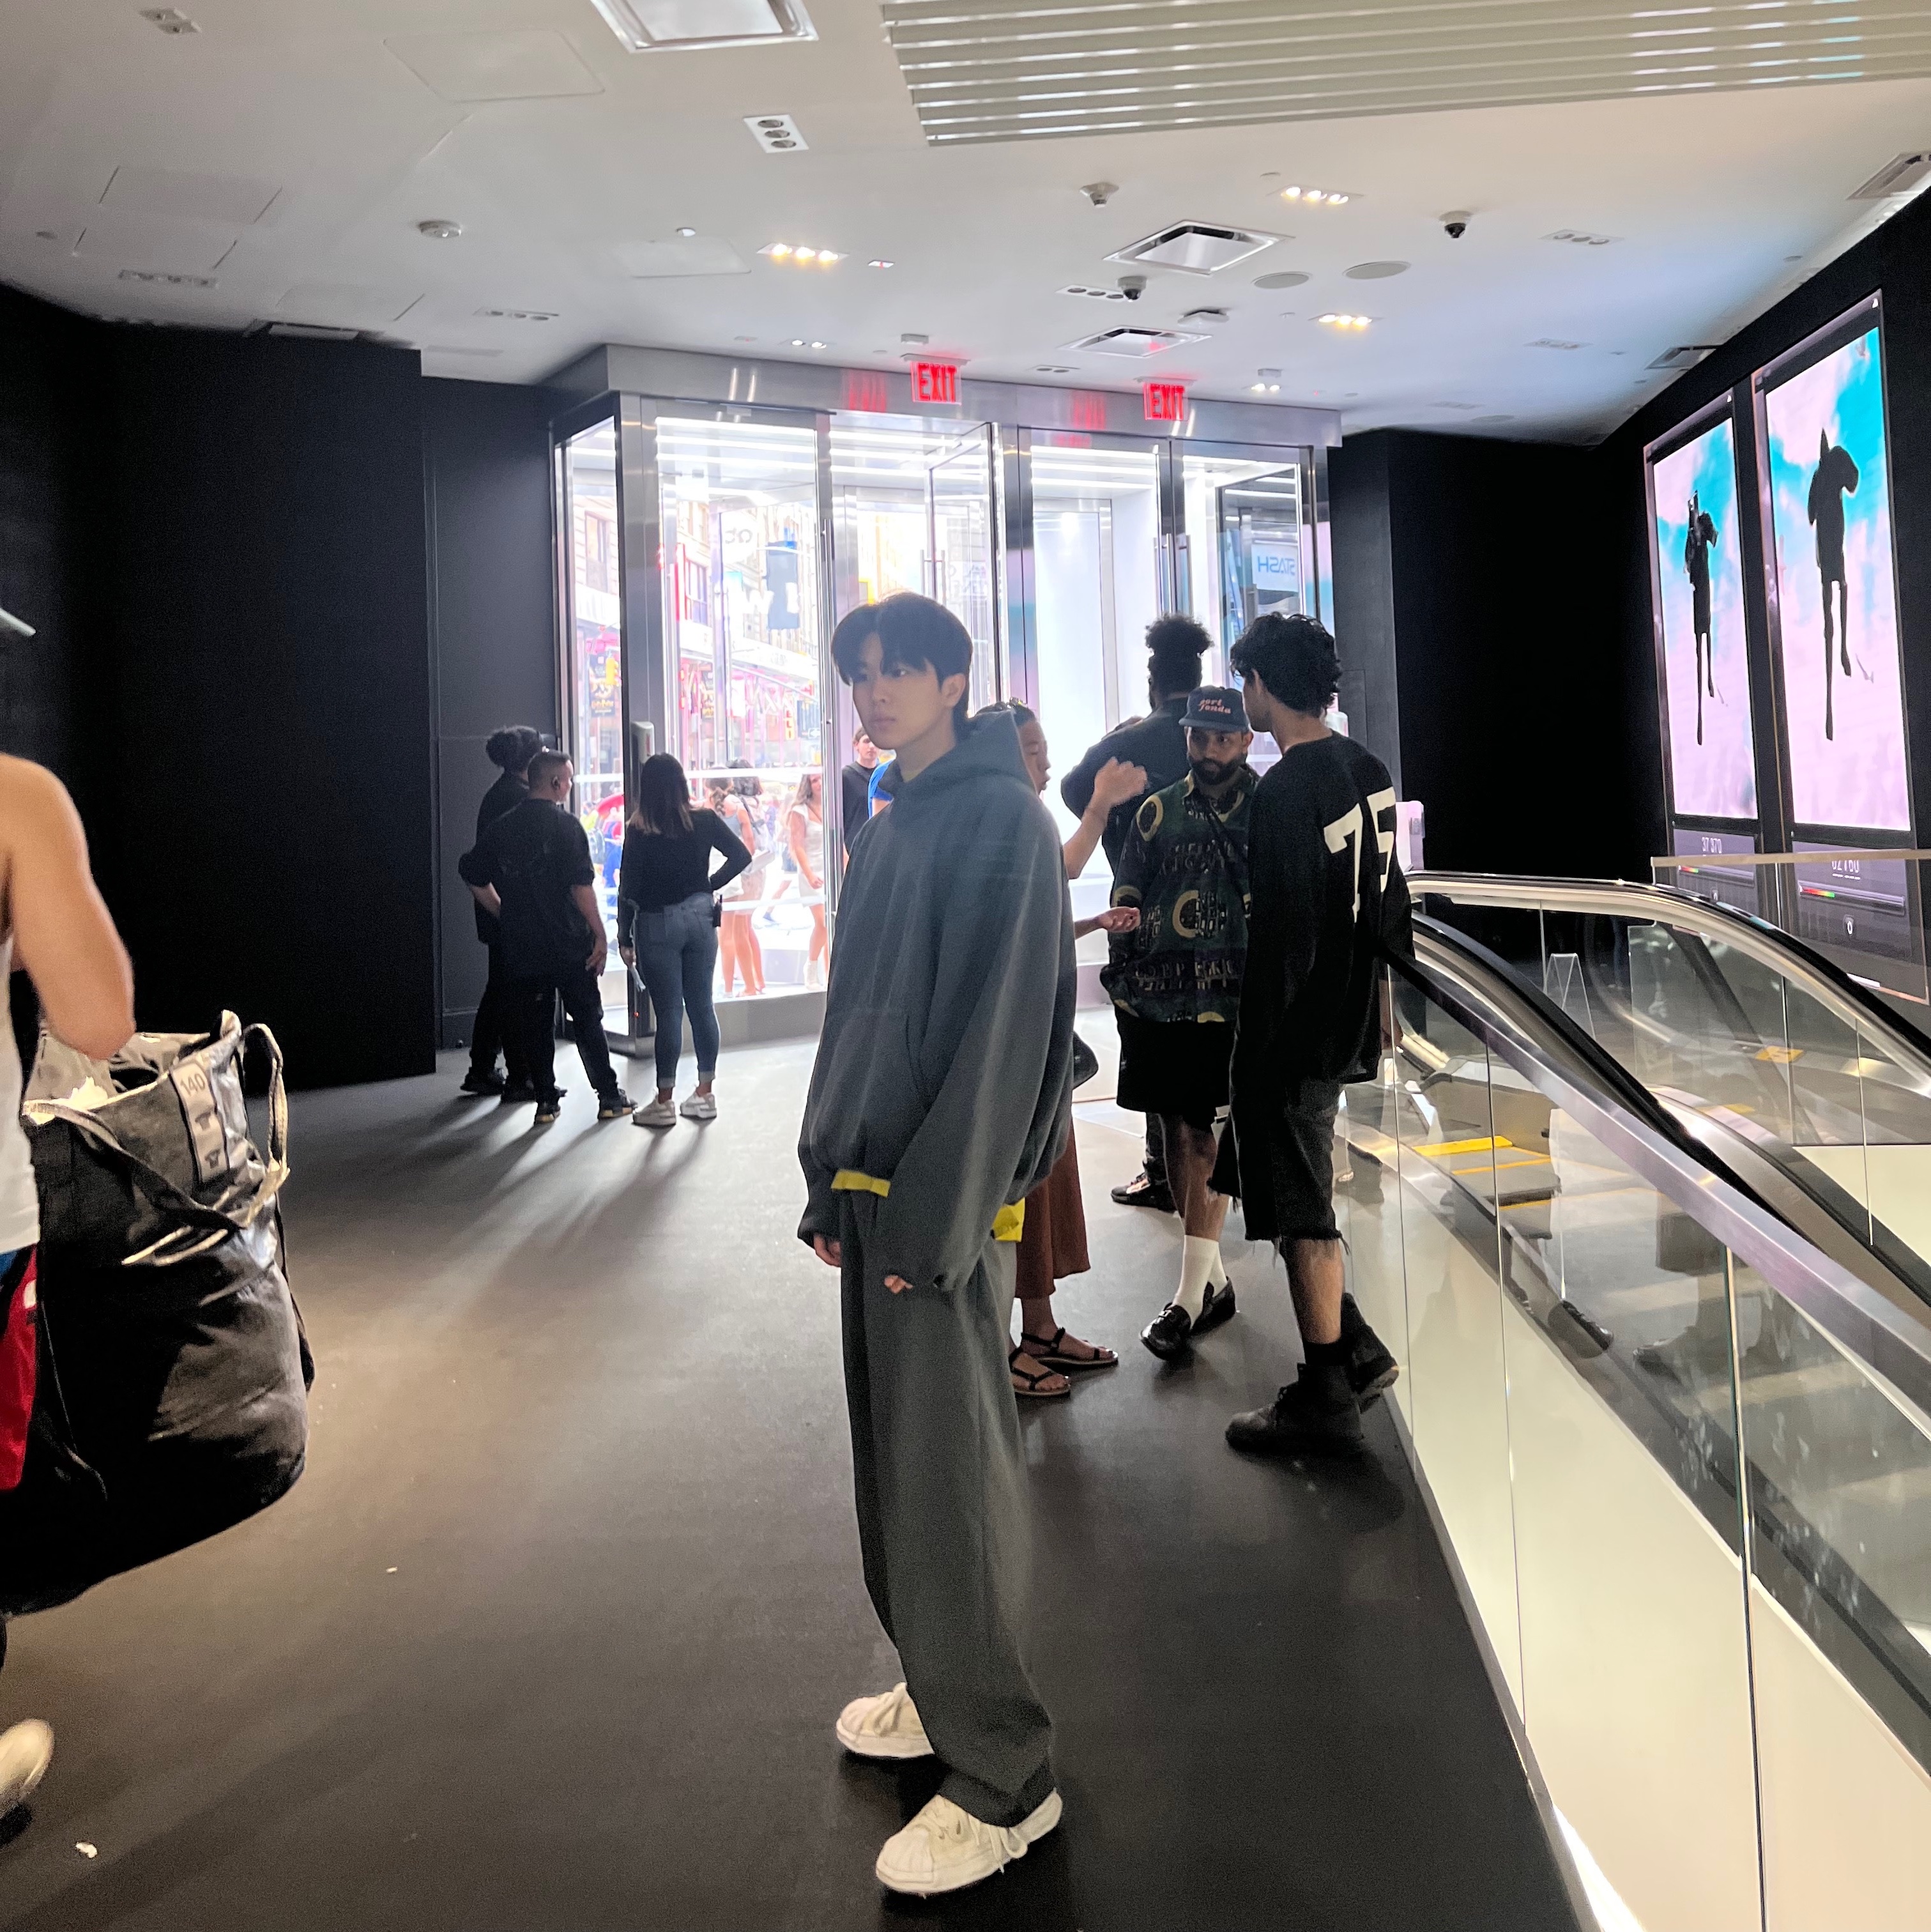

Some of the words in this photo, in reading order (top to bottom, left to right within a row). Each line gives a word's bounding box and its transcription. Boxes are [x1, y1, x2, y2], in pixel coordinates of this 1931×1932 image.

[917, 362, 957, 402] EXIT
[1150, 383, 1186, 420] EXIT
[1324, 786, 1396, 923] 75
[179, 1073, 206, 1097] 140
